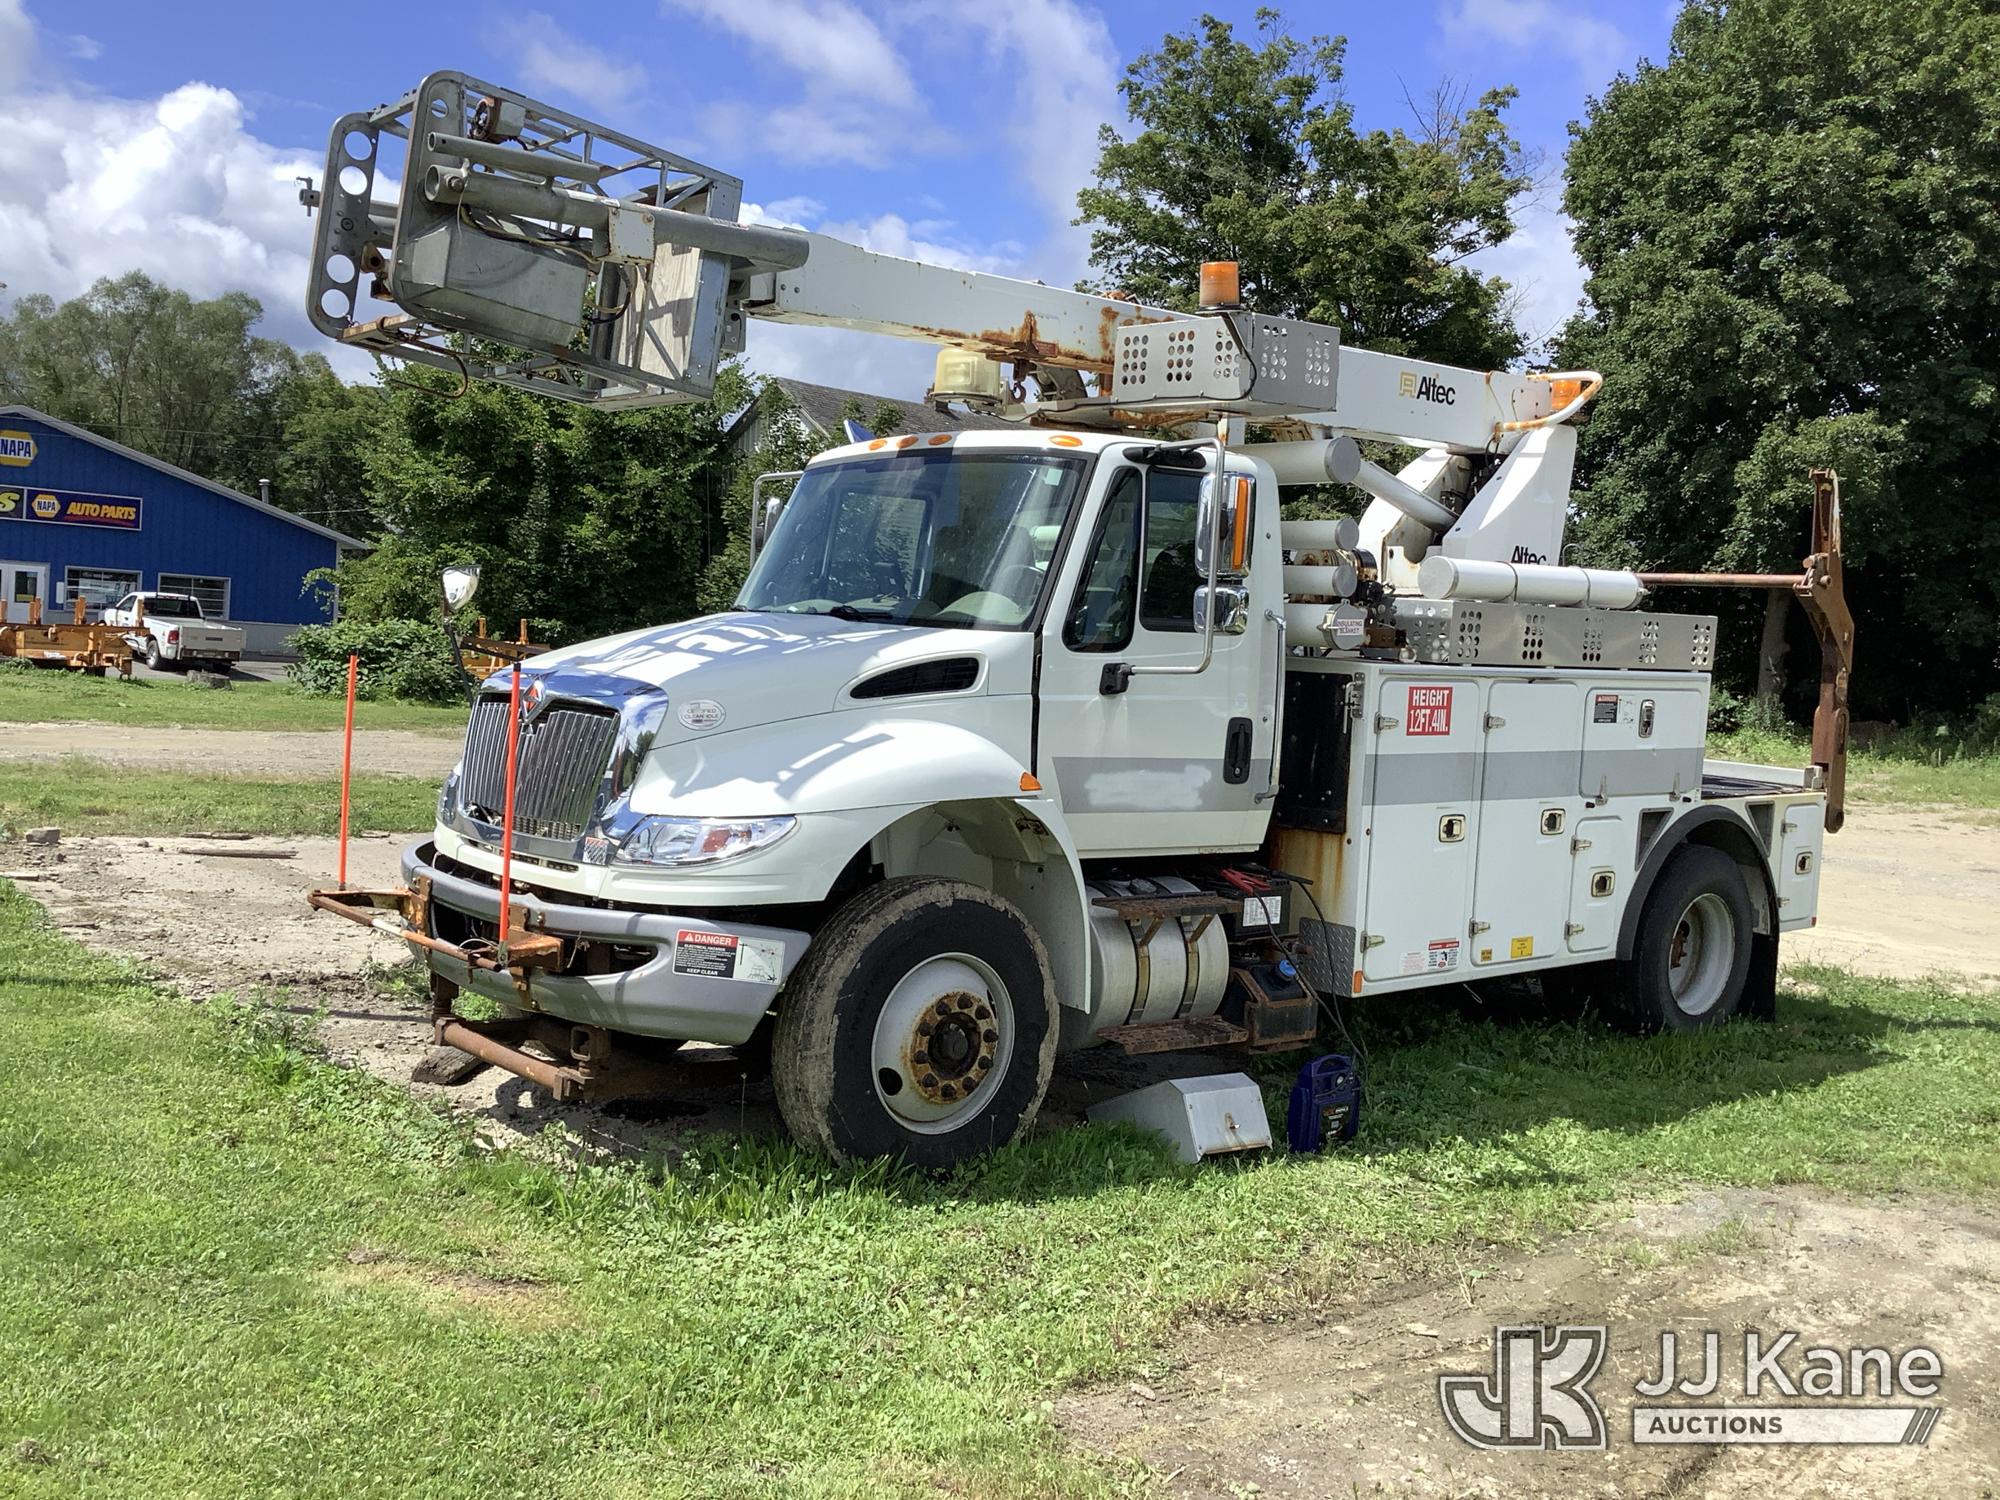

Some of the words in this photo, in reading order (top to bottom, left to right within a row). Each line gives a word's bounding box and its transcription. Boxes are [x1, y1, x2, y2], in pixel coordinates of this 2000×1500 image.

[1416, 376, 1456, 406] Altec
[0, 438, 32, 457] NAPA
[36, 500, 56, 512] NAPA
[66, 502, 100, 516] AUTO
[101, 504, 136, 520] PARTS
[1412, 689, 1450, 706] HEIGHT
[1408, 708, 1449, 733] 12FT.4IN.
[694, 934, 732, 946] DANGER
